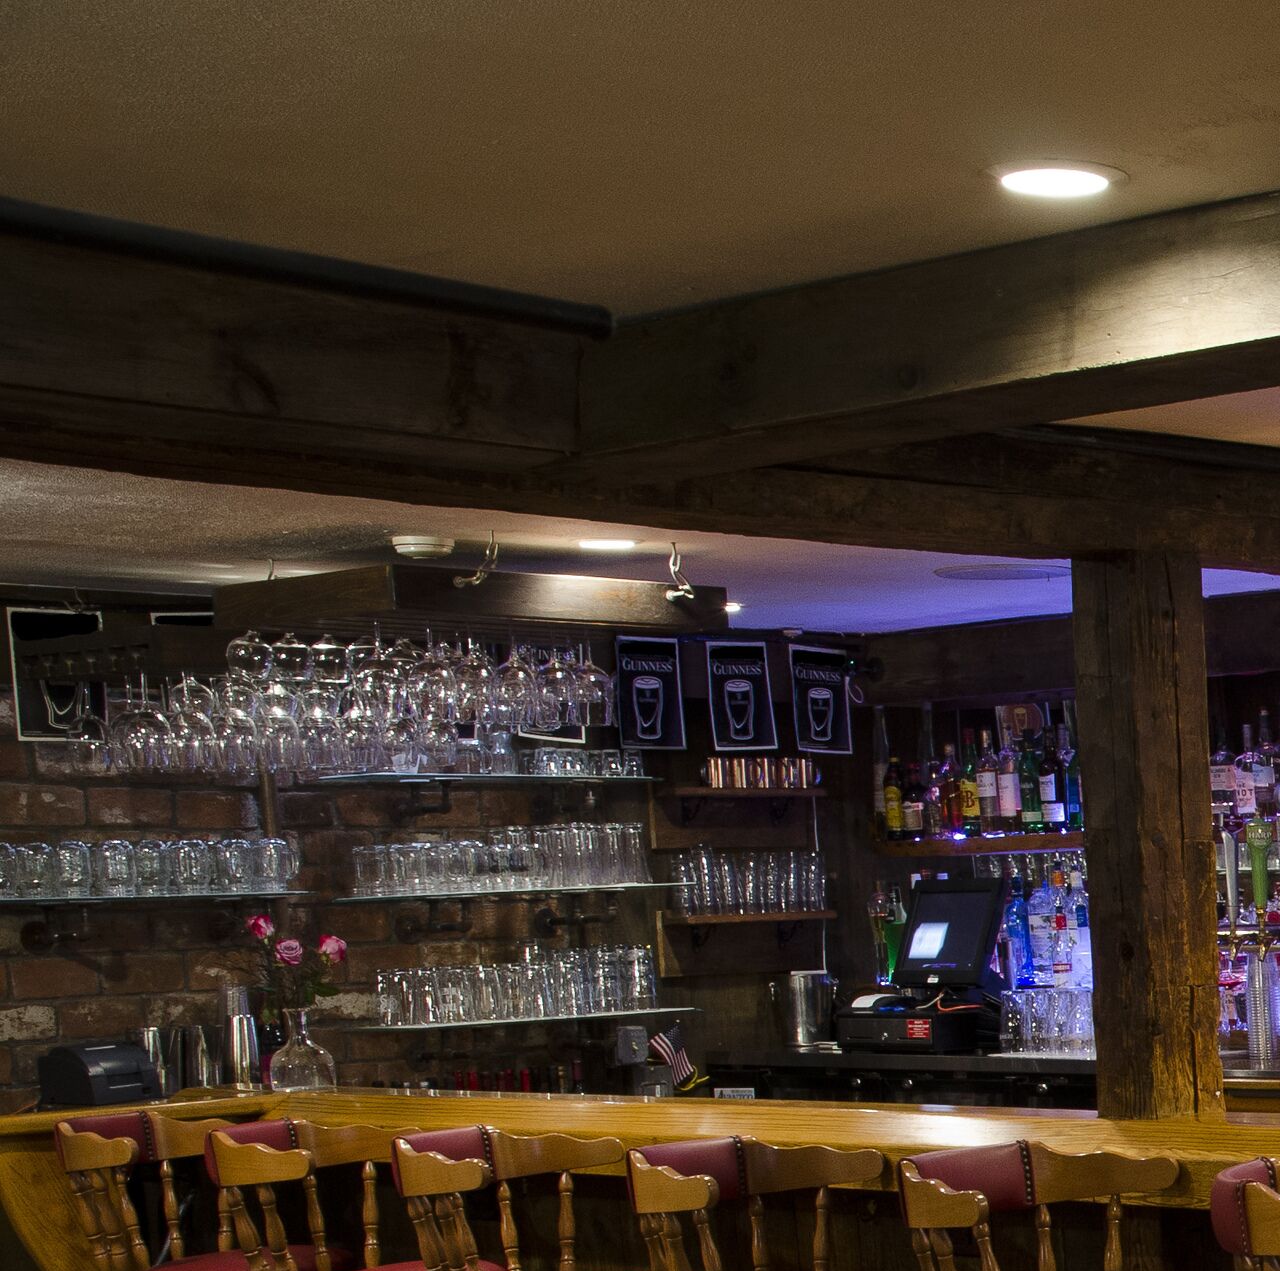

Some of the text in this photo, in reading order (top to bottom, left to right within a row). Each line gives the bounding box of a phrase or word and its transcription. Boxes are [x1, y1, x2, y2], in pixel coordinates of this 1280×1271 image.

[622, 657, 673, 673] GUINNESS
[713, 663, 762, 675] GUINNESS
[796, 667, 841, 681] GUINNESS
[1249, 831, 1272, 839] HARP
